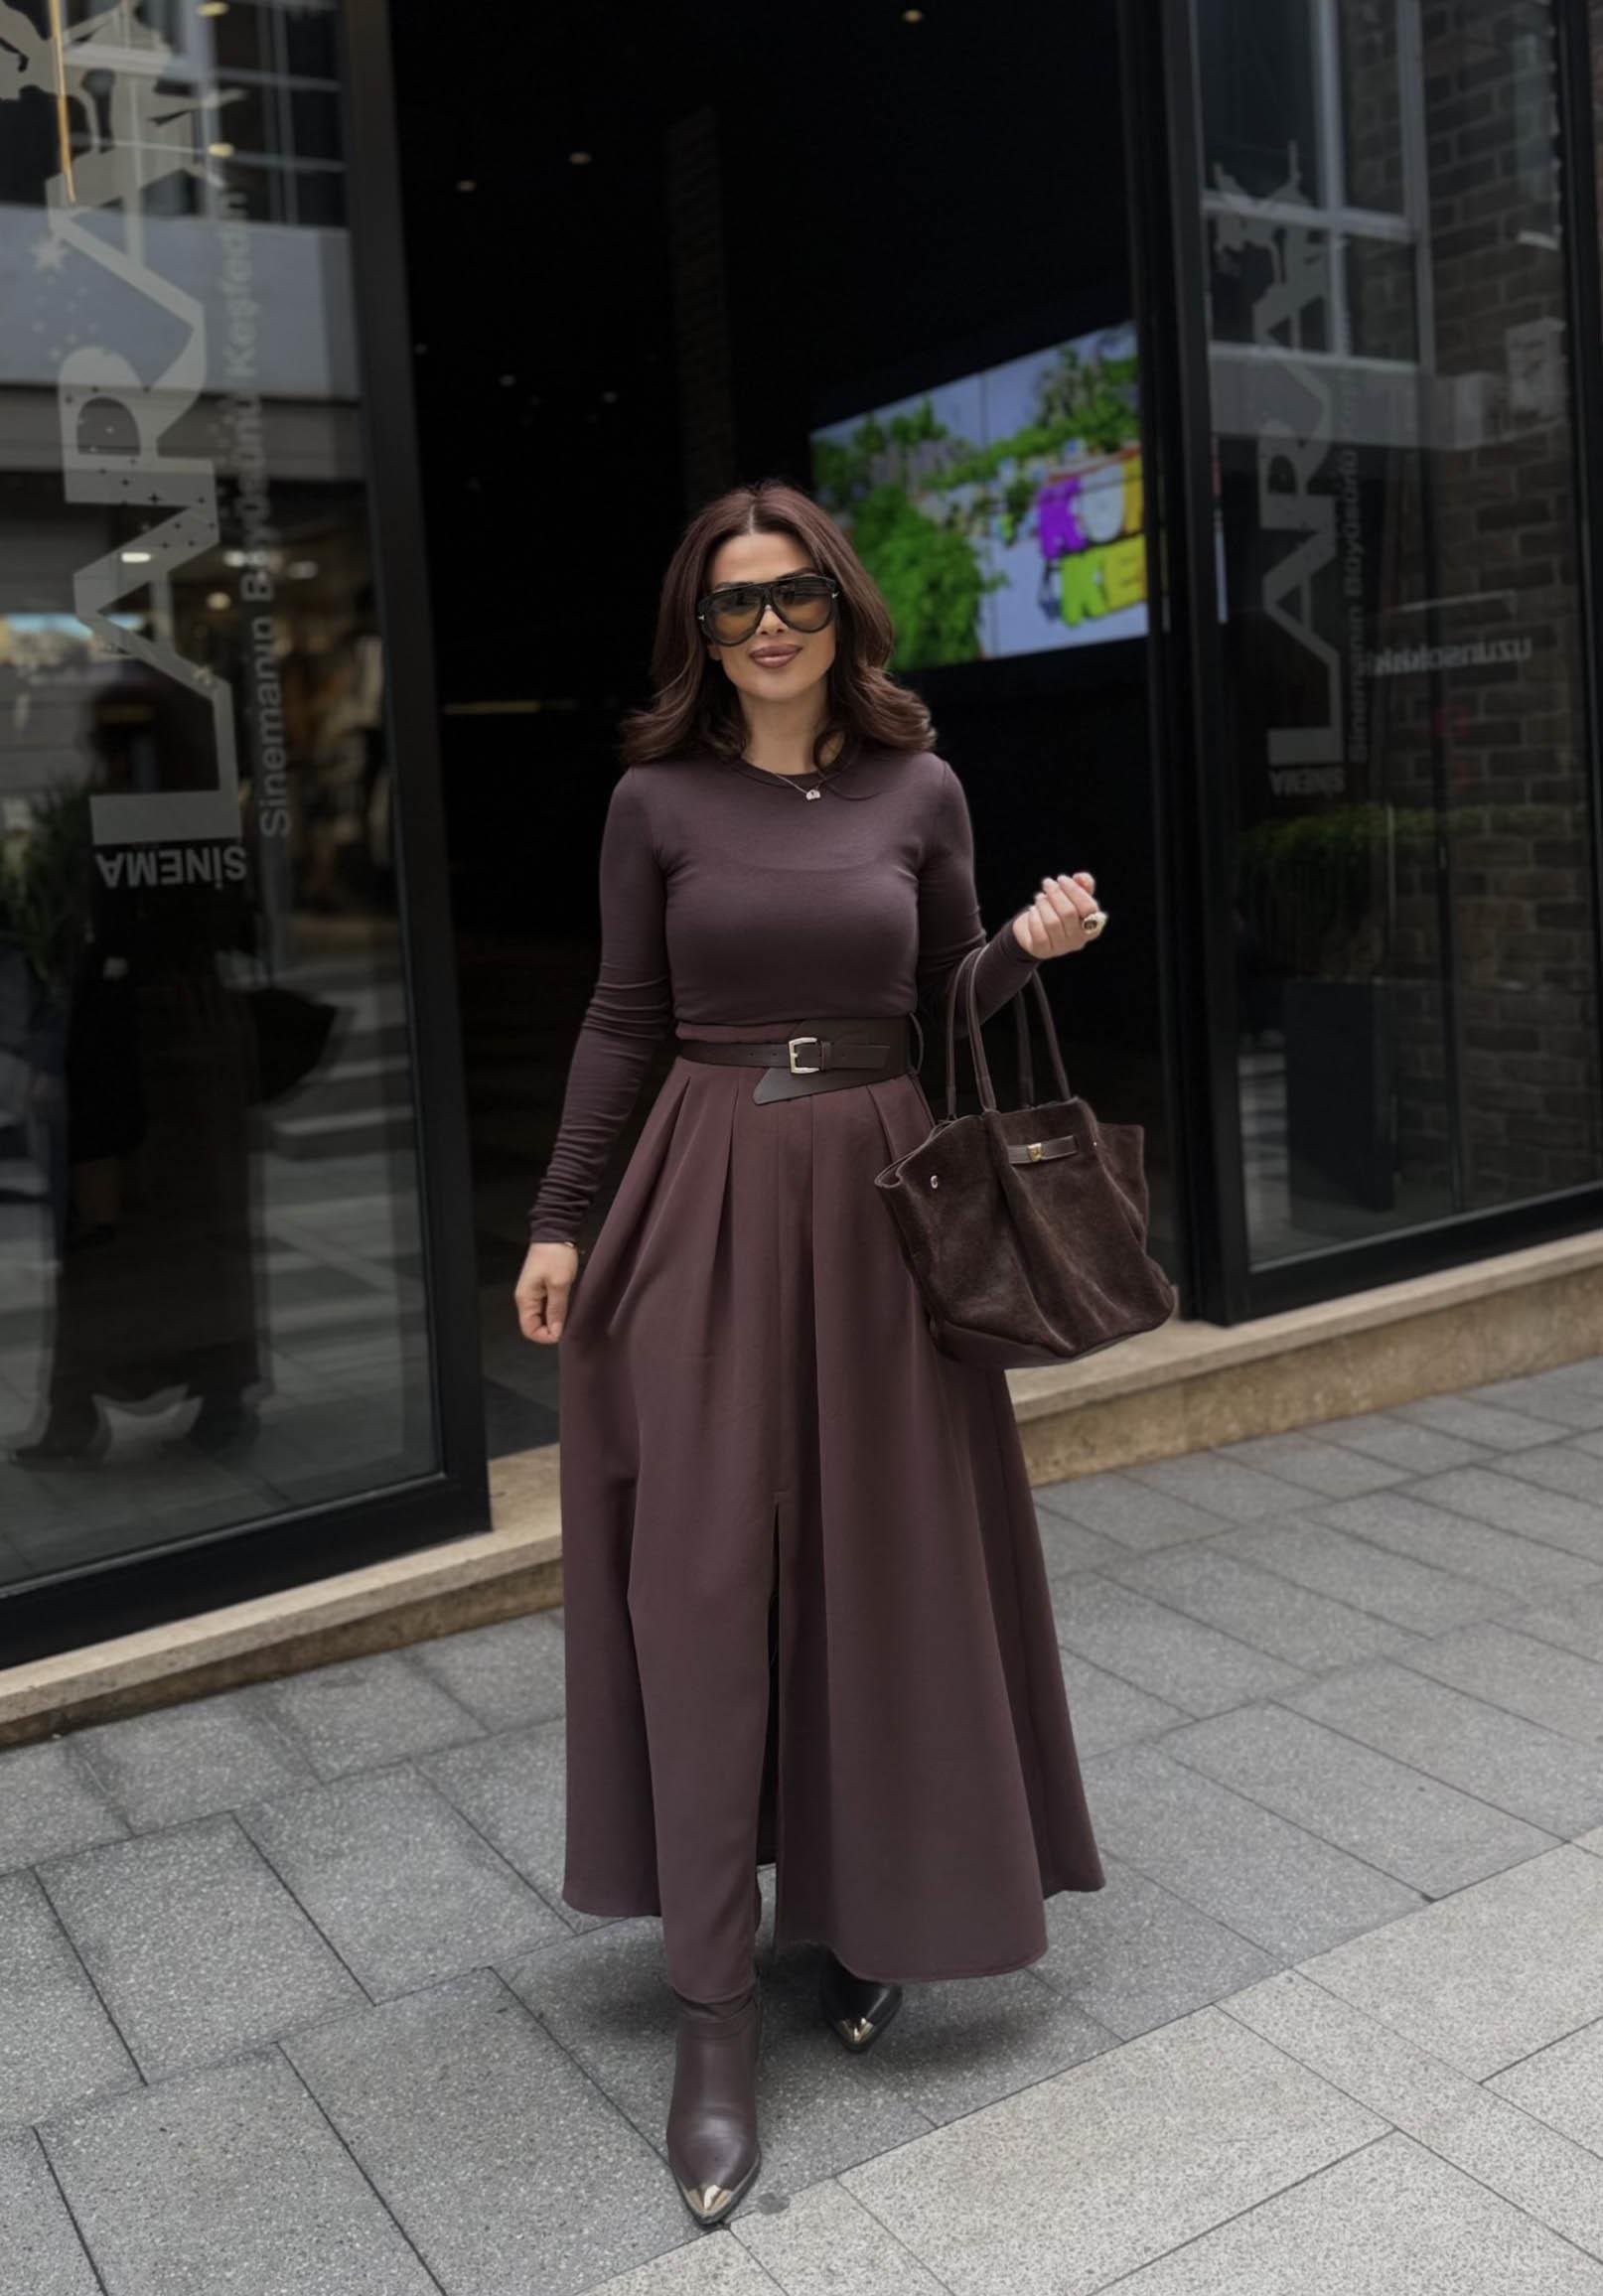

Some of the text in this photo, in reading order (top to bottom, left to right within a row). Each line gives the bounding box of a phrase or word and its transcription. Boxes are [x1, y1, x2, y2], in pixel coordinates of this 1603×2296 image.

[47, 117, 241, 845] LARA
[214, 192, 291, 837] Sinemanın Byüsünü Keşfedn
[1252, 266, 1343, 766] LARA
